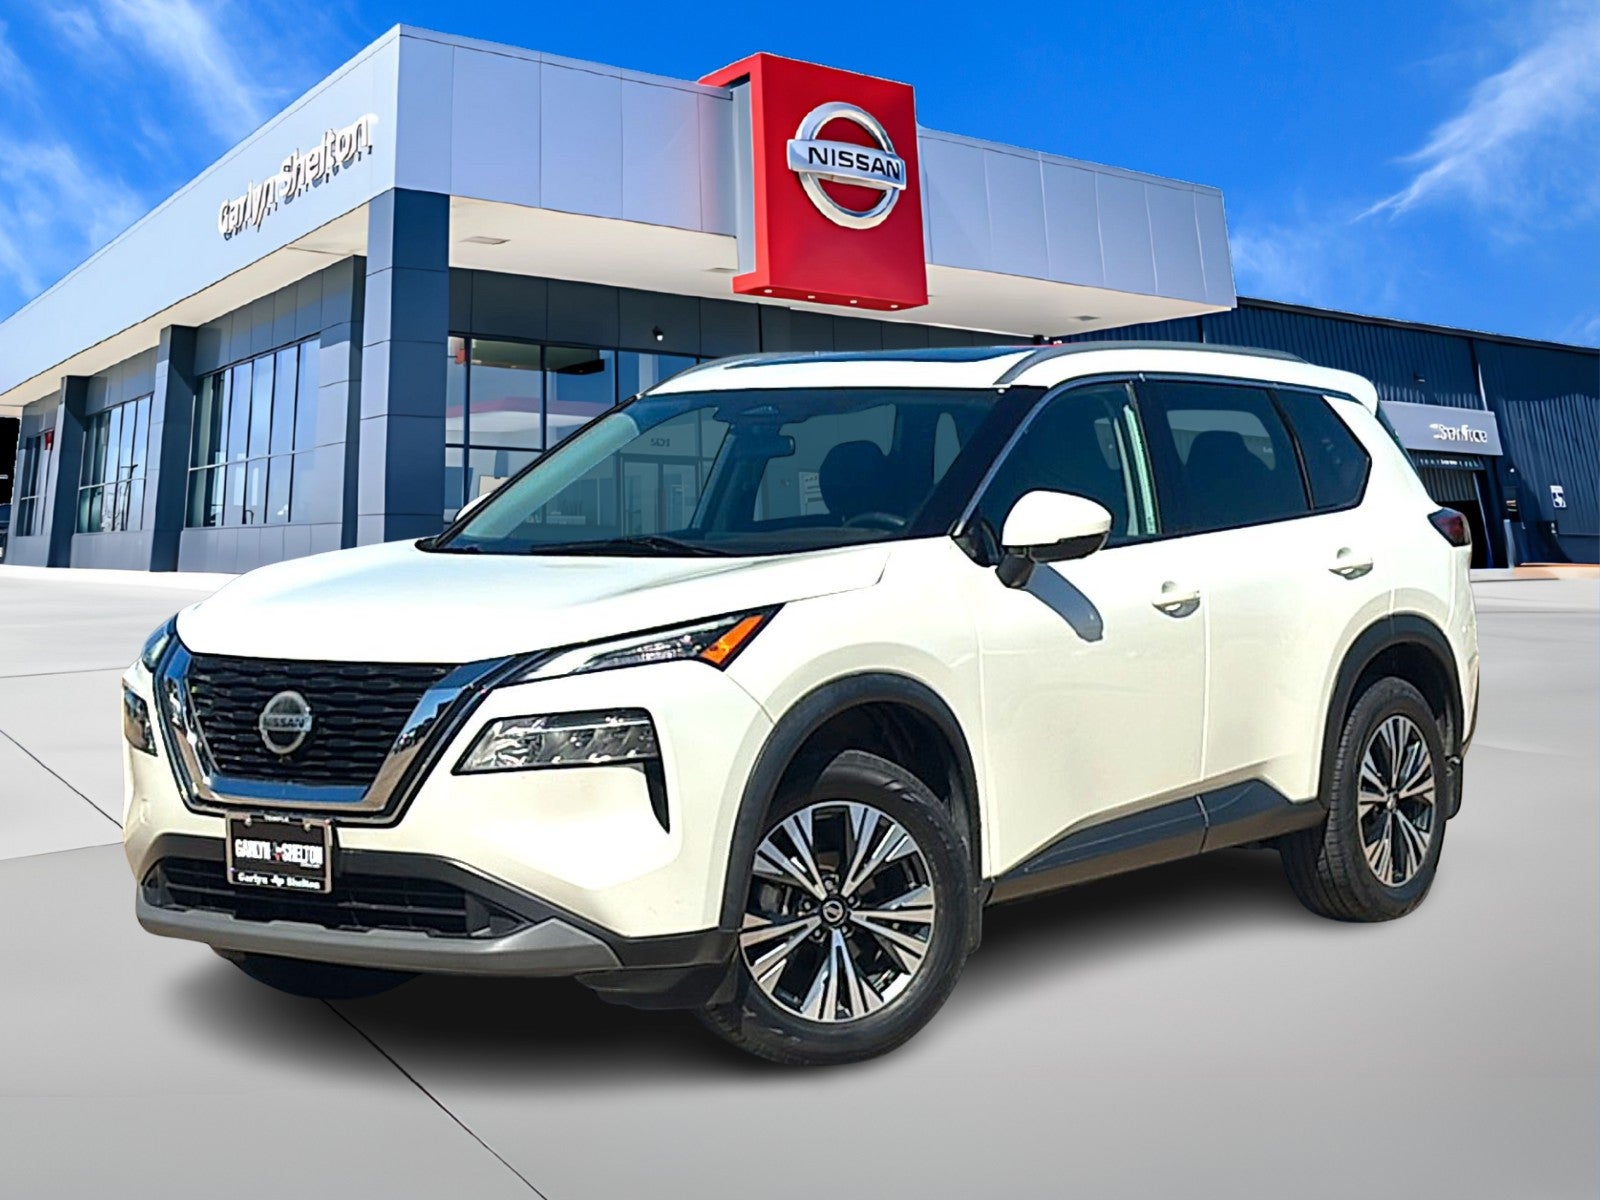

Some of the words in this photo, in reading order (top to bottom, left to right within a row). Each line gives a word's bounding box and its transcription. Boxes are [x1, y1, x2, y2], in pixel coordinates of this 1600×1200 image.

[278, 118, 373, 204] Shelton
[808, 146, 900, 180] NISSAN
[281, 843, 323, 865] SHELTON
